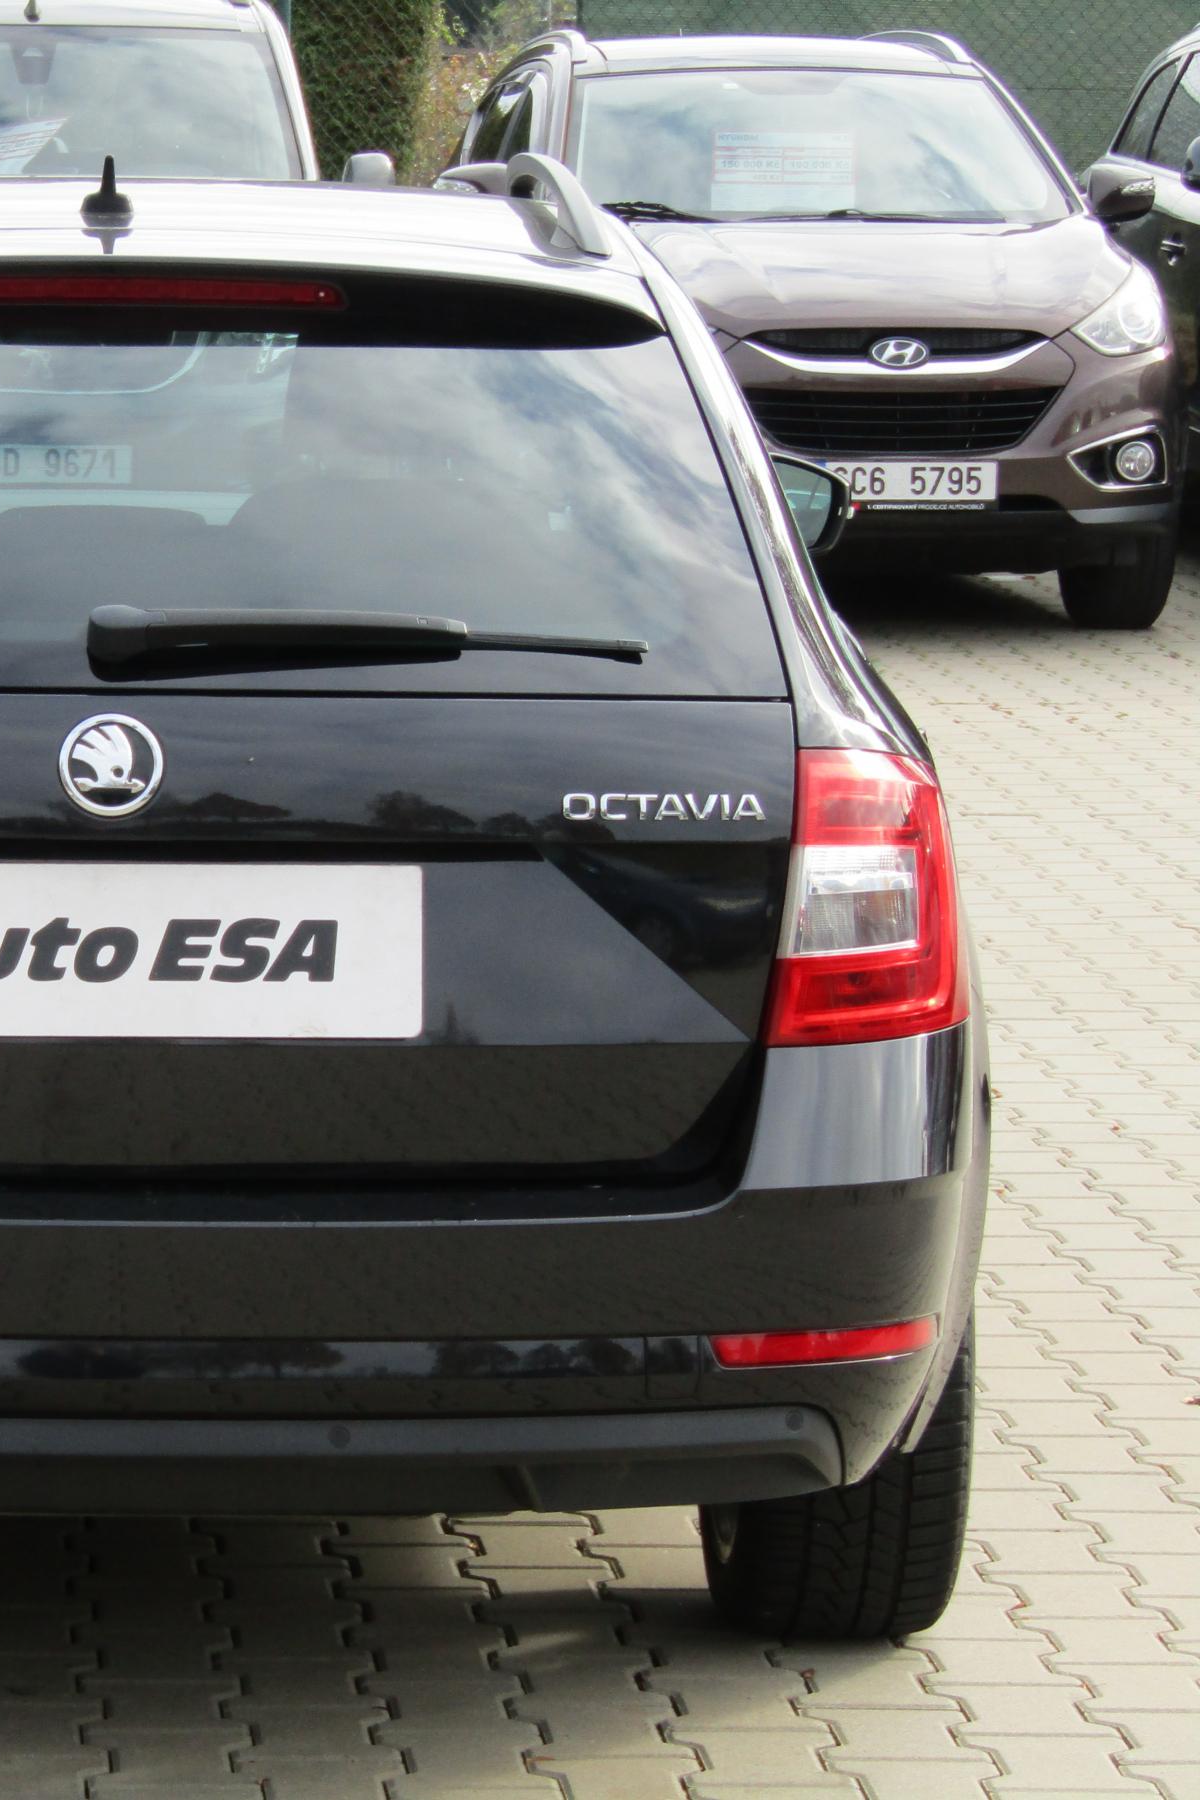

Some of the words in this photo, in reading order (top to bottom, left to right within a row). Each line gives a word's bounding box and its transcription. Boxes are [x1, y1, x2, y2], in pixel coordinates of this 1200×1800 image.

[45, 447, 117, 479] 9671
[910, 466, 982, 495] 5795
[562, 792, 768, 821] OCTAVIA
[148, 918, 339, 983] ESA
